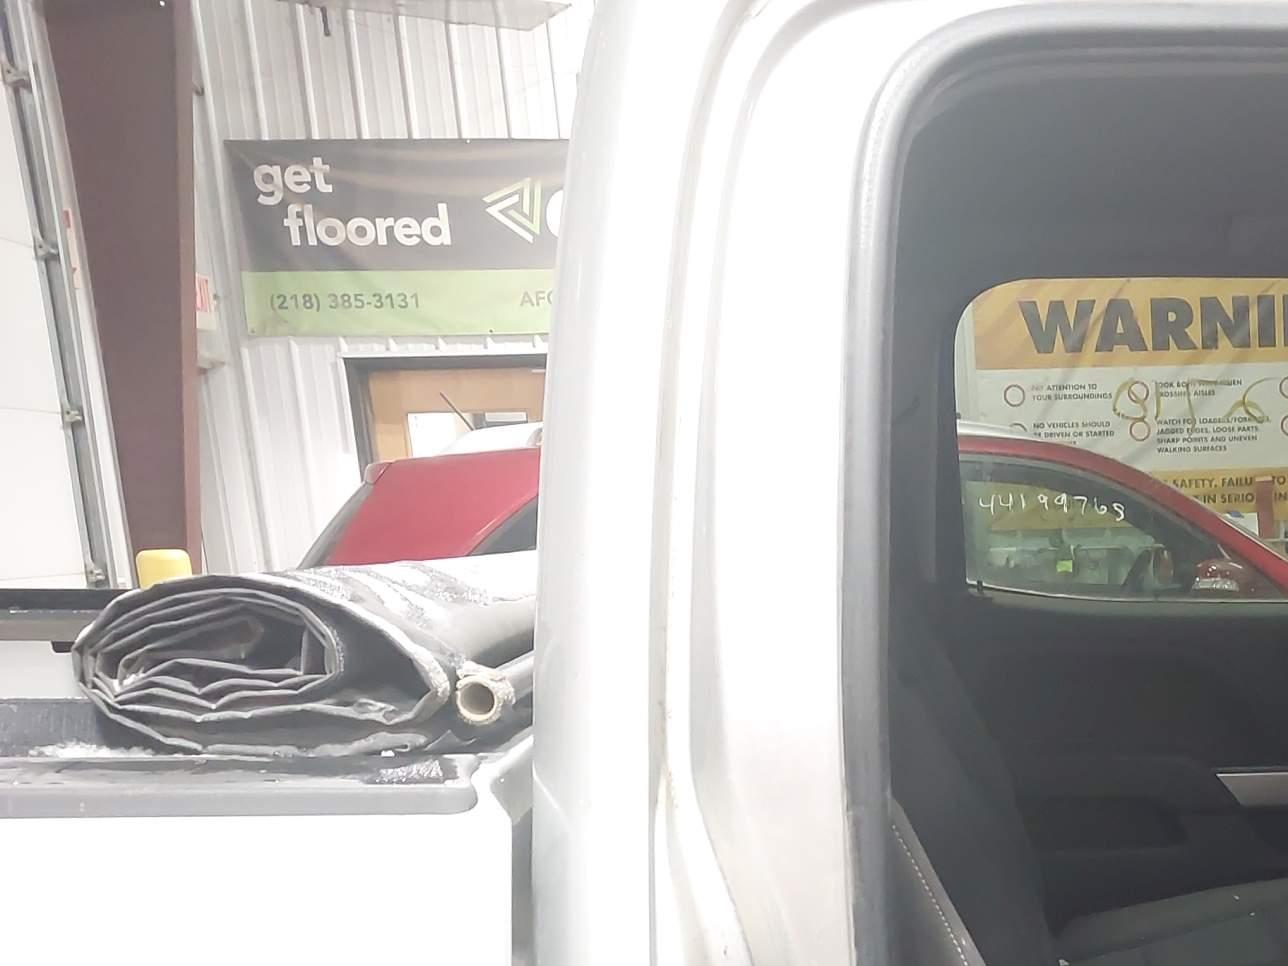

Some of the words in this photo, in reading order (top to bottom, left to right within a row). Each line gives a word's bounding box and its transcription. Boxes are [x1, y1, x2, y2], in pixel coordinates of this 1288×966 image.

[253, 157, 333, 206] get
[283, 202, 452, 247] floored
[269, 292, 321, 312] (218)
[329, 291, 421, 310] 385-3131
[520, 290, 553, 308] AF
[1054, 392, 1113, 401] SURROUNDINGS
[1047, 421, 1079, 429] VEHICLES
[1212, 426, 1234, 434] LOOSE
[1228, 434, 1258, 442] UNEVEN
[1157, 446, 1191, 454] WALKING
[1193, 445, 1227, 453] SURFACES
[1221, 475, 1254, 488] FAILU
[1203, 494, 1217, 504] IN
[1220, 492, 1255, 504] SERIO
